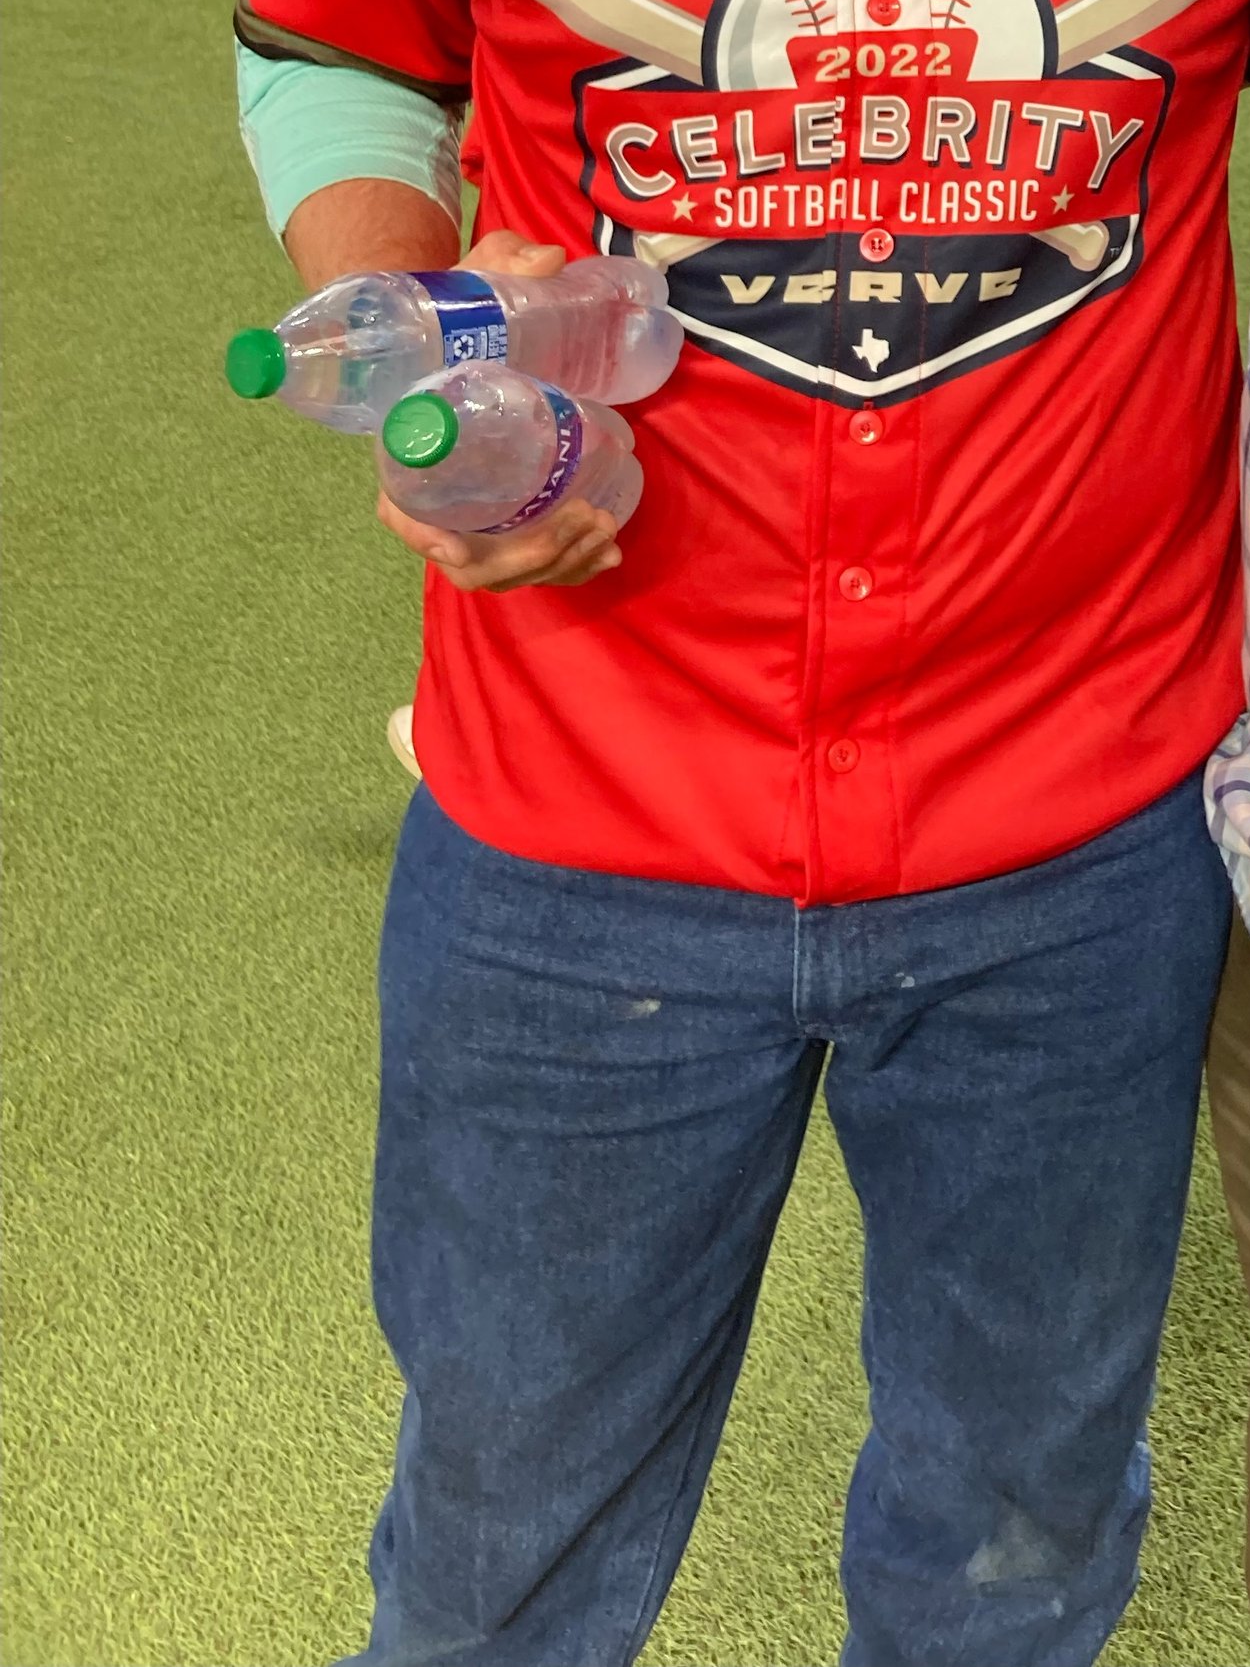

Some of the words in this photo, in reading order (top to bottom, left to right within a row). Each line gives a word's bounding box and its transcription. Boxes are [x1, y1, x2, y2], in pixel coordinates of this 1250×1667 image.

[814, 41, 951, 83] 2022
[605, 95, 1144, 200] CELEBRITY
[714, 178, 884, 228] SOFTBALL
[900, 179, 1040, 223] CLASSIC
[720, 267, 1023, 305] VERVE
